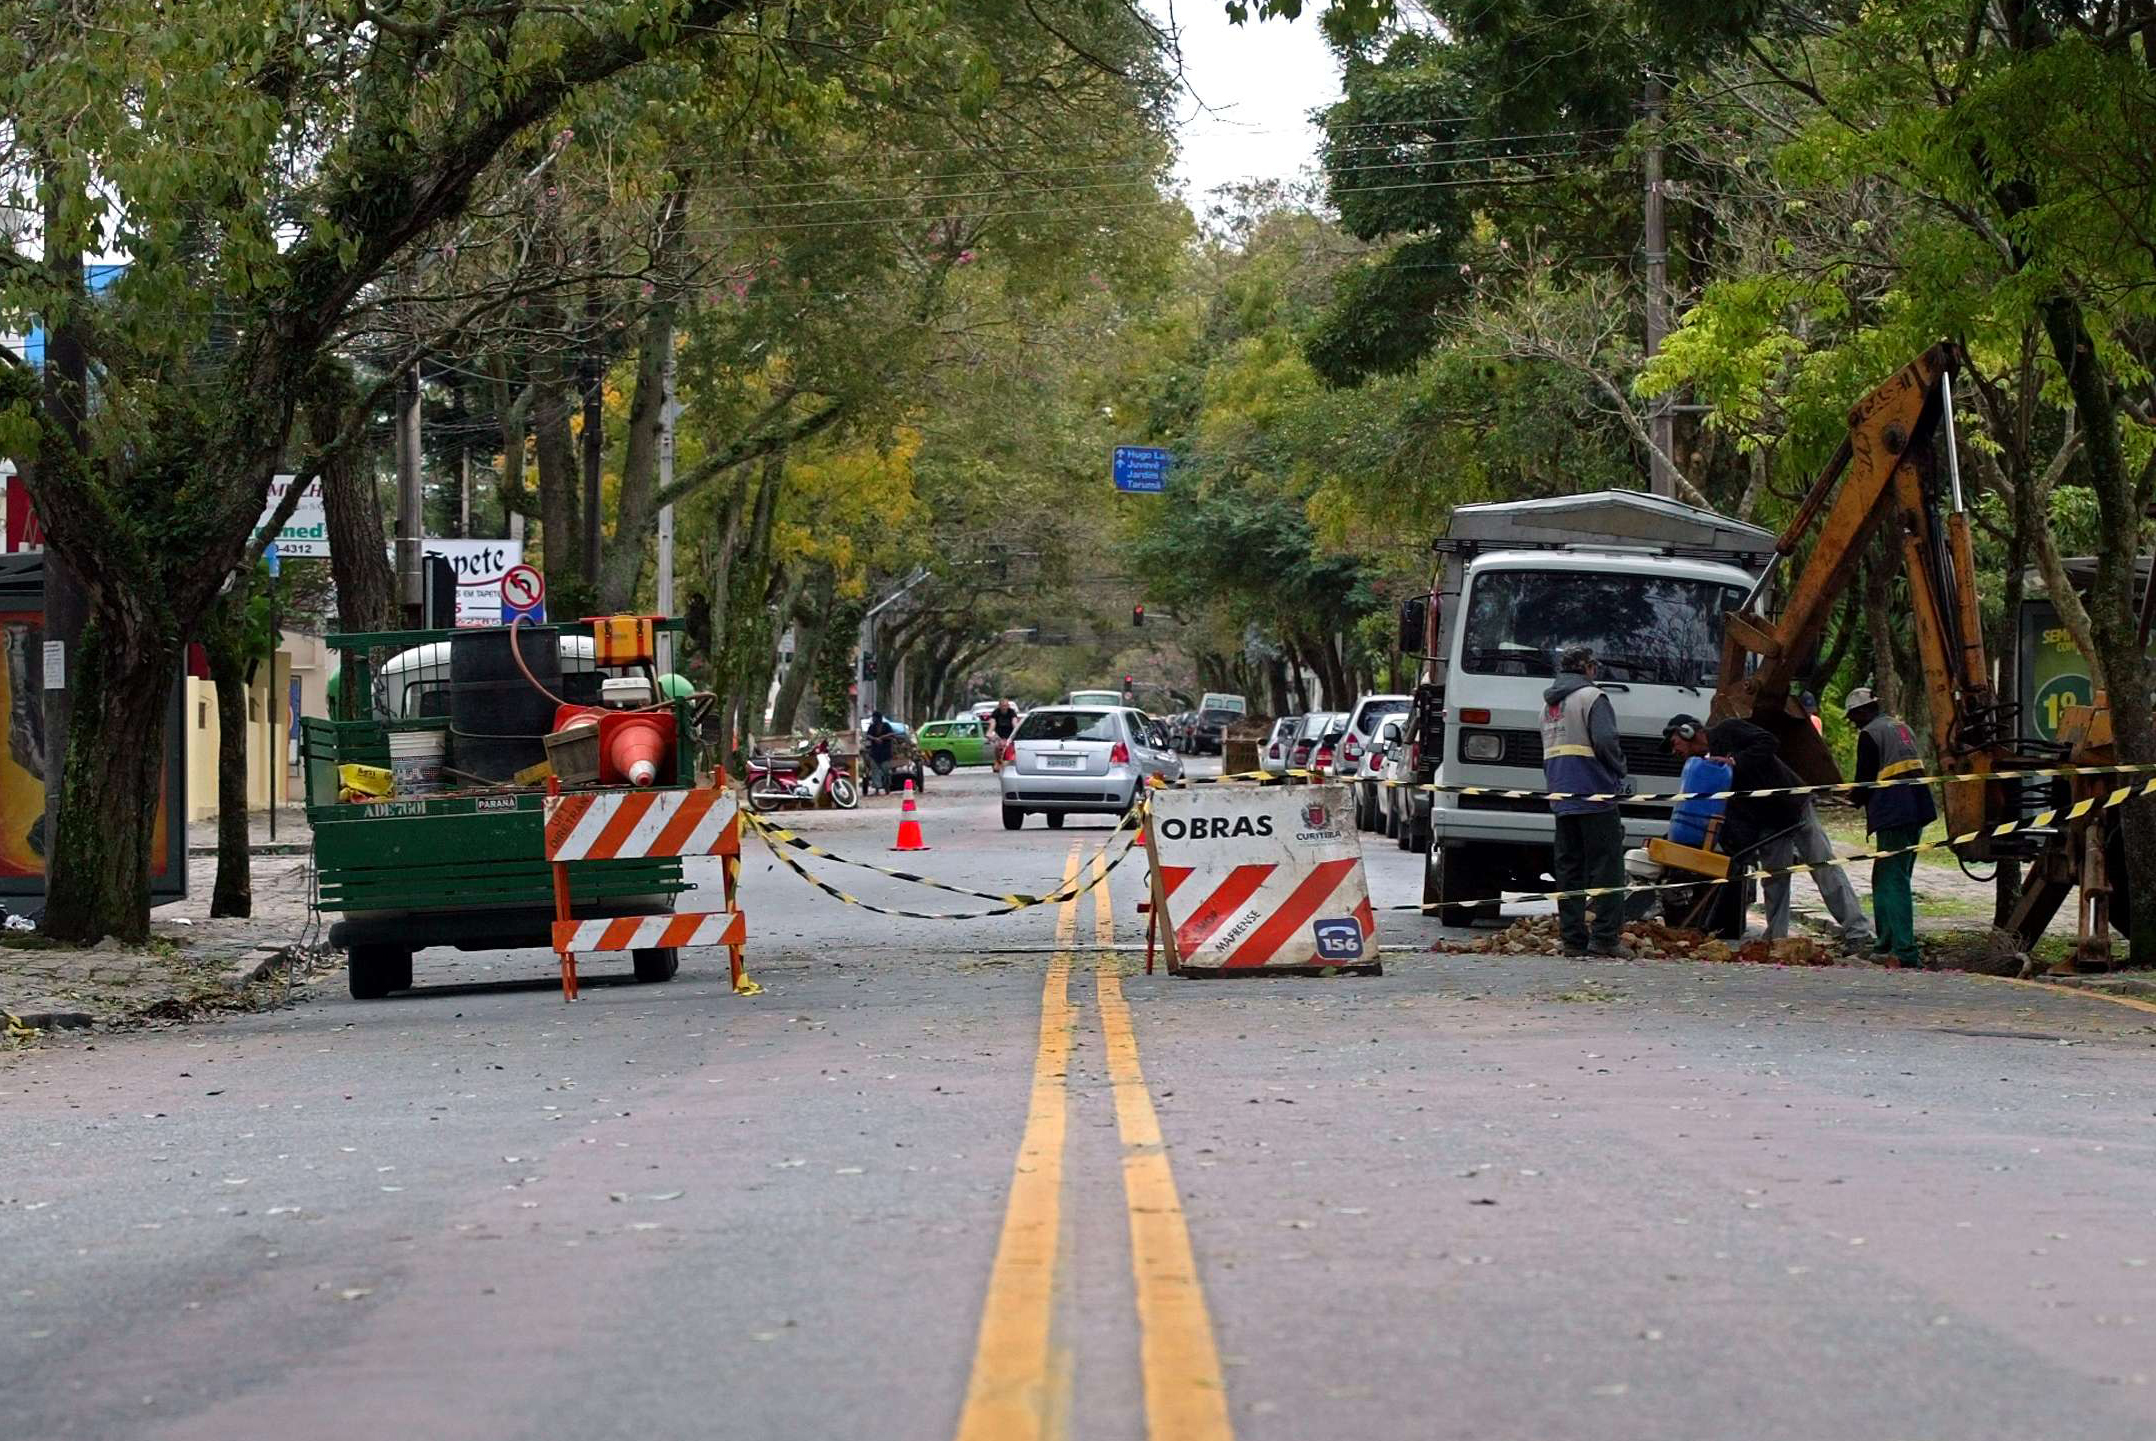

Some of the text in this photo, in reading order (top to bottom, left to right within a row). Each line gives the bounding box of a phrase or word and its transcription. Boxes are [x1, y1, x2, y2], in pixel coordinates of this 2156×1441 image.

[1127, 450, 1152, 461] Hugo
[1161, 814, 1273, 840] OBRAS
[1296, 830, 1341, 841] CURITIBA
[1215, 910, 1261, 953] MAFRENSE
[1323, 938, 1359, 952] 156
